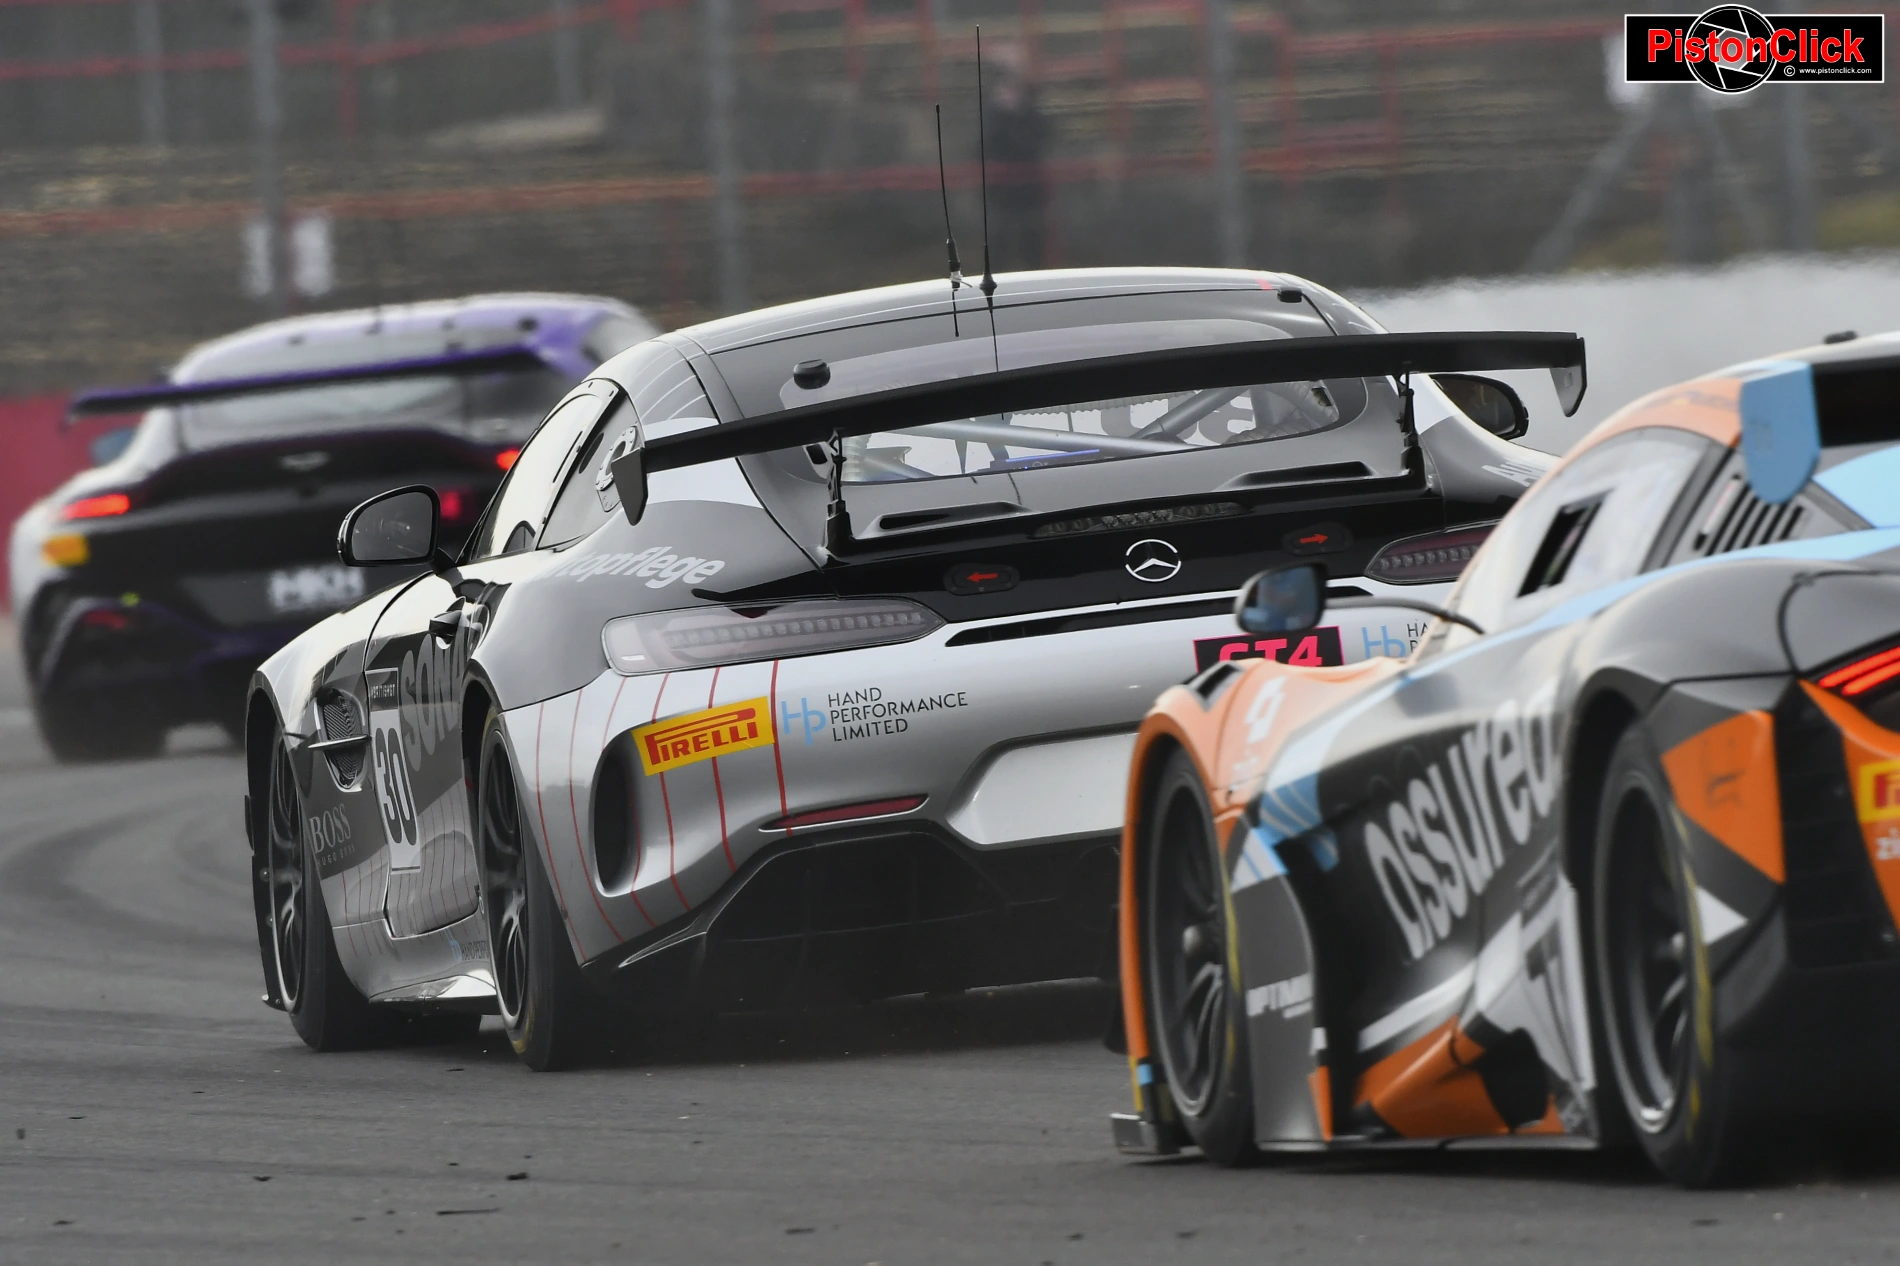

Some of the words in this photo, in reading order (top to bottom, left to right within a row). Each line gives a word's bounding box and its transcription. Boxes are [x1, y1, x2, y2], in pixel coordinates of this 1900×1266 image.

[828, 687, 882, 708] HAND
[830, 692, 968, 724] PERFORMANCE
[644, 707, 759, 766] PIRELLI
[832, 718, 908, 742] LIMITED
[376, 727, 417, 846] 30
[309, 803, 351, 854] BOSS
